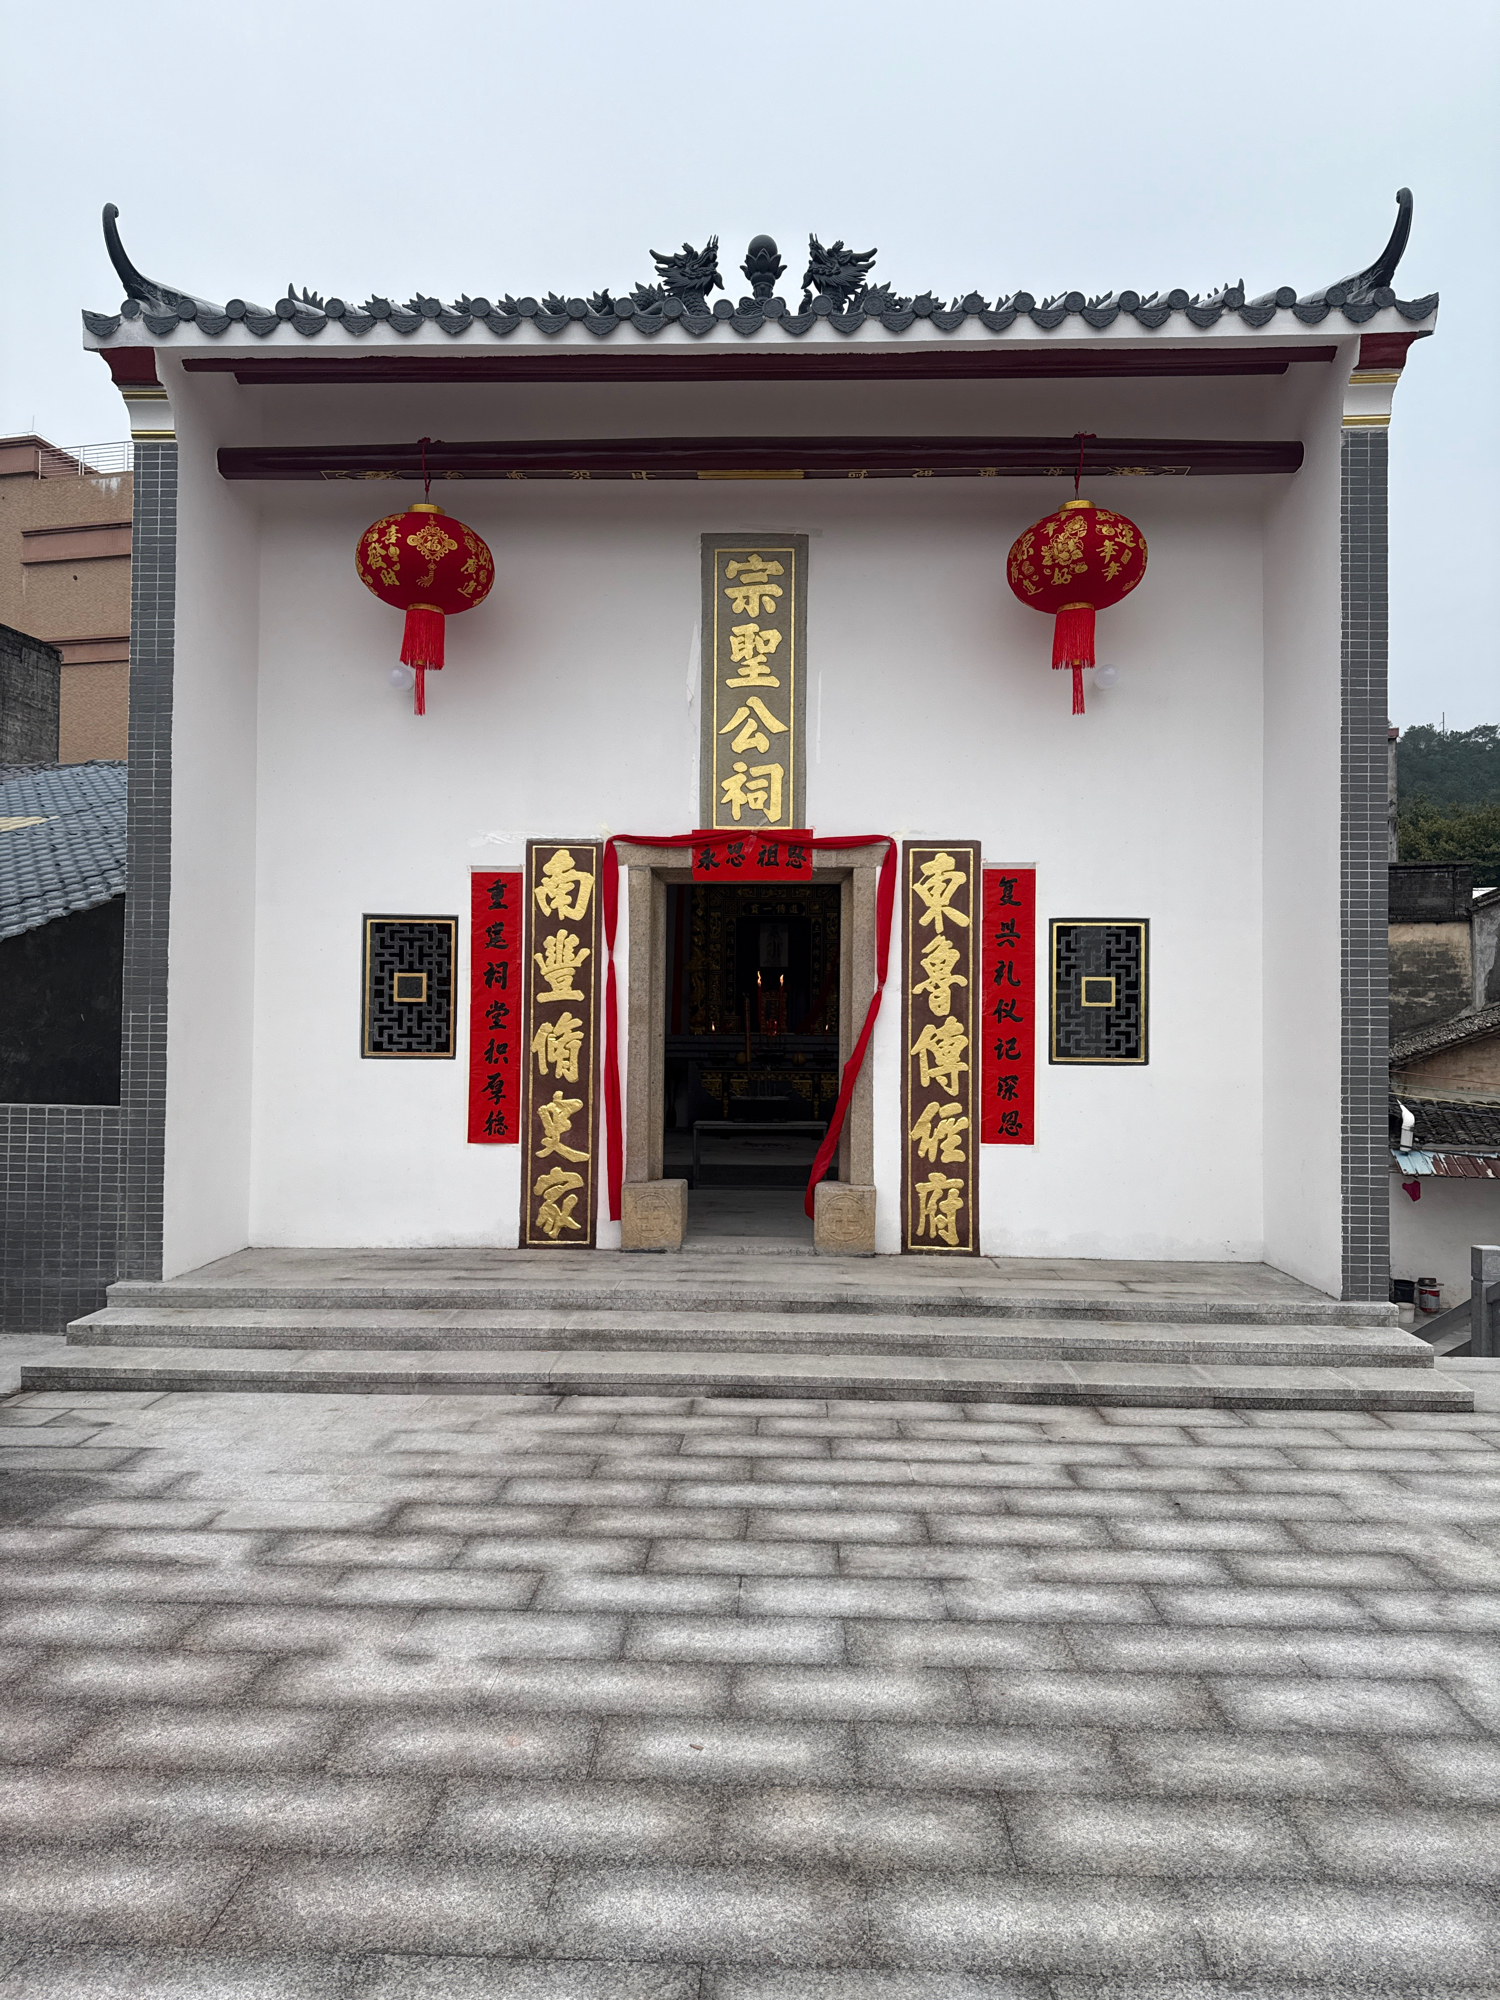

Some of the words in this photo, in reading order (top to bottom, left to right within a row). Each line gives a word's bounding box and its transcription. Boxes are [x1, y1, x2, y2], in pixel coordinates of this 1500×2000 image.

[719, 554, 789, 824] 宗聖公祠
[696, 841, 807, 871] 永思祖恩
[481, 878, 509, 1137] 重建祠堂积厚德
